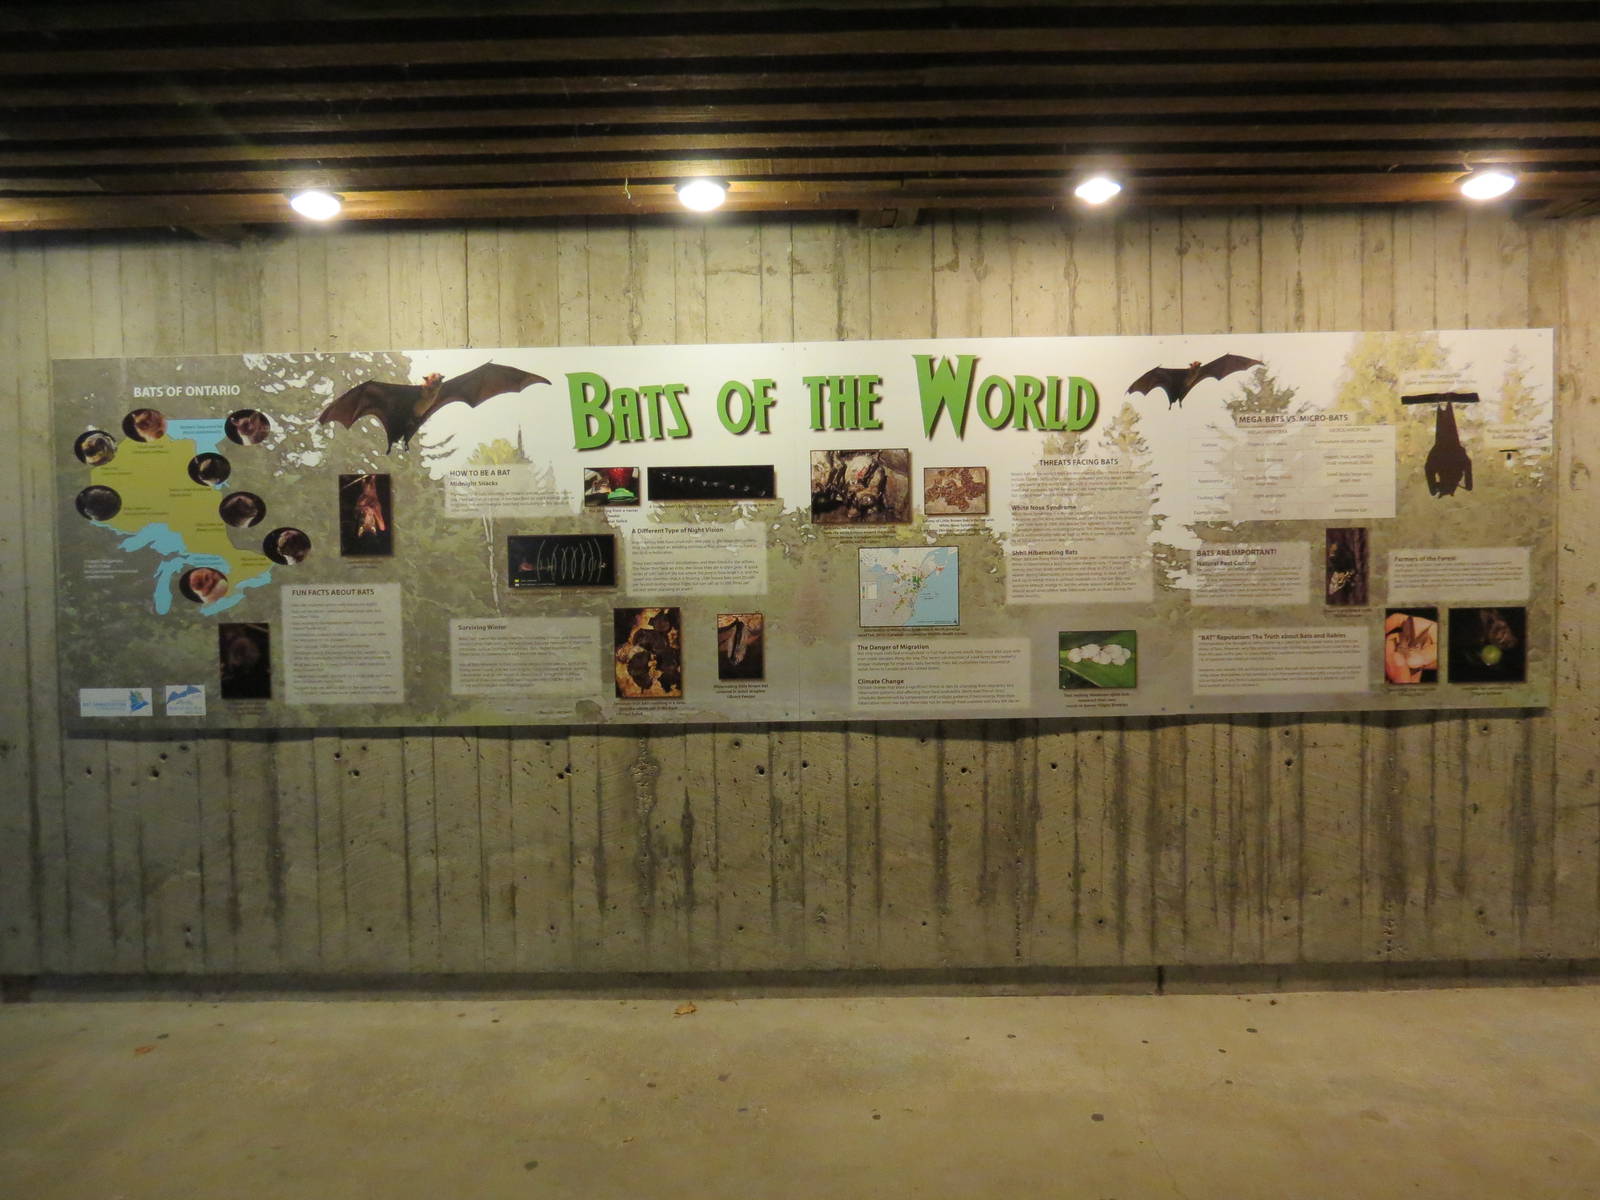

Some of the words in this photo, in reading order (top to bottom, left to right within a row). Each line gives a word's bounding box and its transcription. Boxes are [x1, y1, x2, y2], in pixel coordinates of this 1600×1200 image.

[133, 386, 163, 398] BATS
[166, 386, 182, 397] OF
[185, 384, 241, 396] ONTARIO
[565, 372, 688, 449] BATS
[717, 378, 775, 434] OF
[802, 375, 880, 429] THE
[912, 354, 1097, 439] WORLD
[1239, 415, 1285, 424] MEGA-BATS
[1300, 414, 1349, 422] MICRO-BATS
